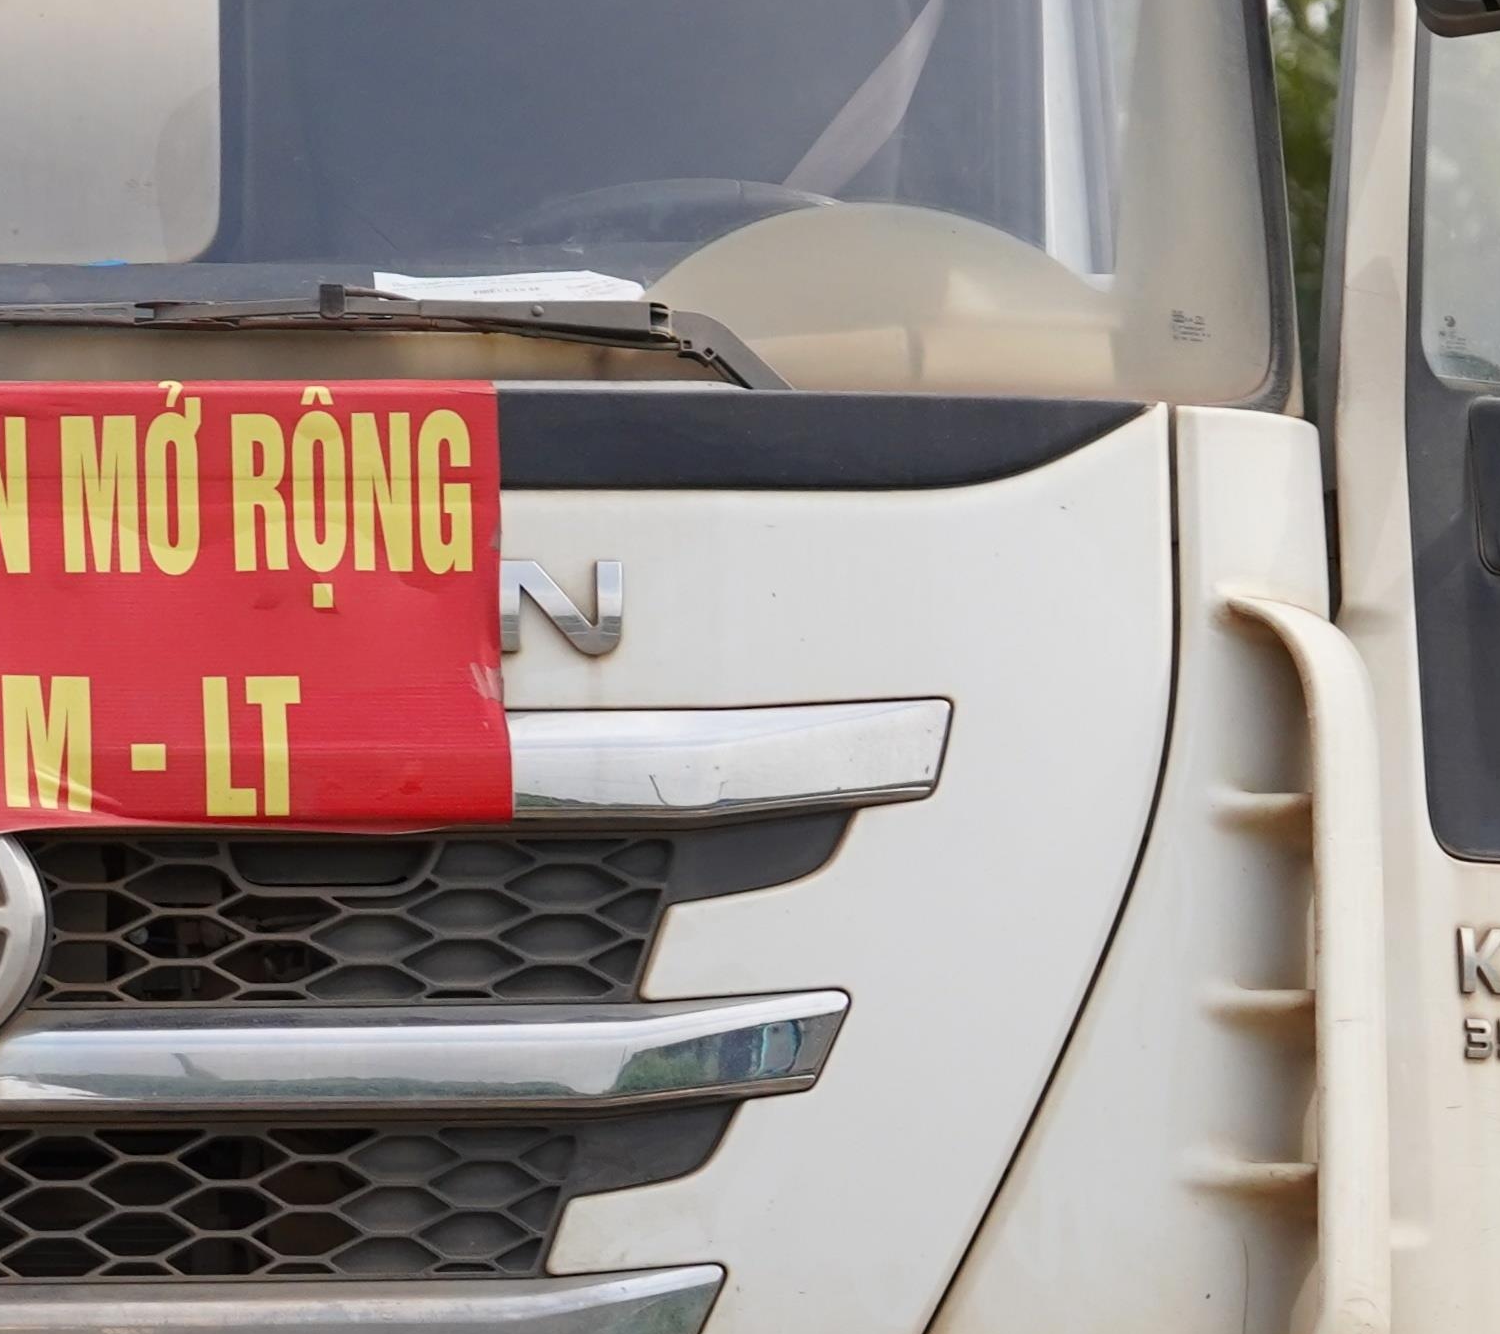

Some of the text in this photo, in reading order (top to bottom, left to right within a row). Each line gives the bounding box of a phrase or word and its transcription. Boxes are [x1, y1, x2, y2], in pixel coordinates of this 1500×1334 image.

[60, 380, 203, 577] MỞ
[230, 385, 475, 610] RỘNG
[202, 674, 302, 818] LT
